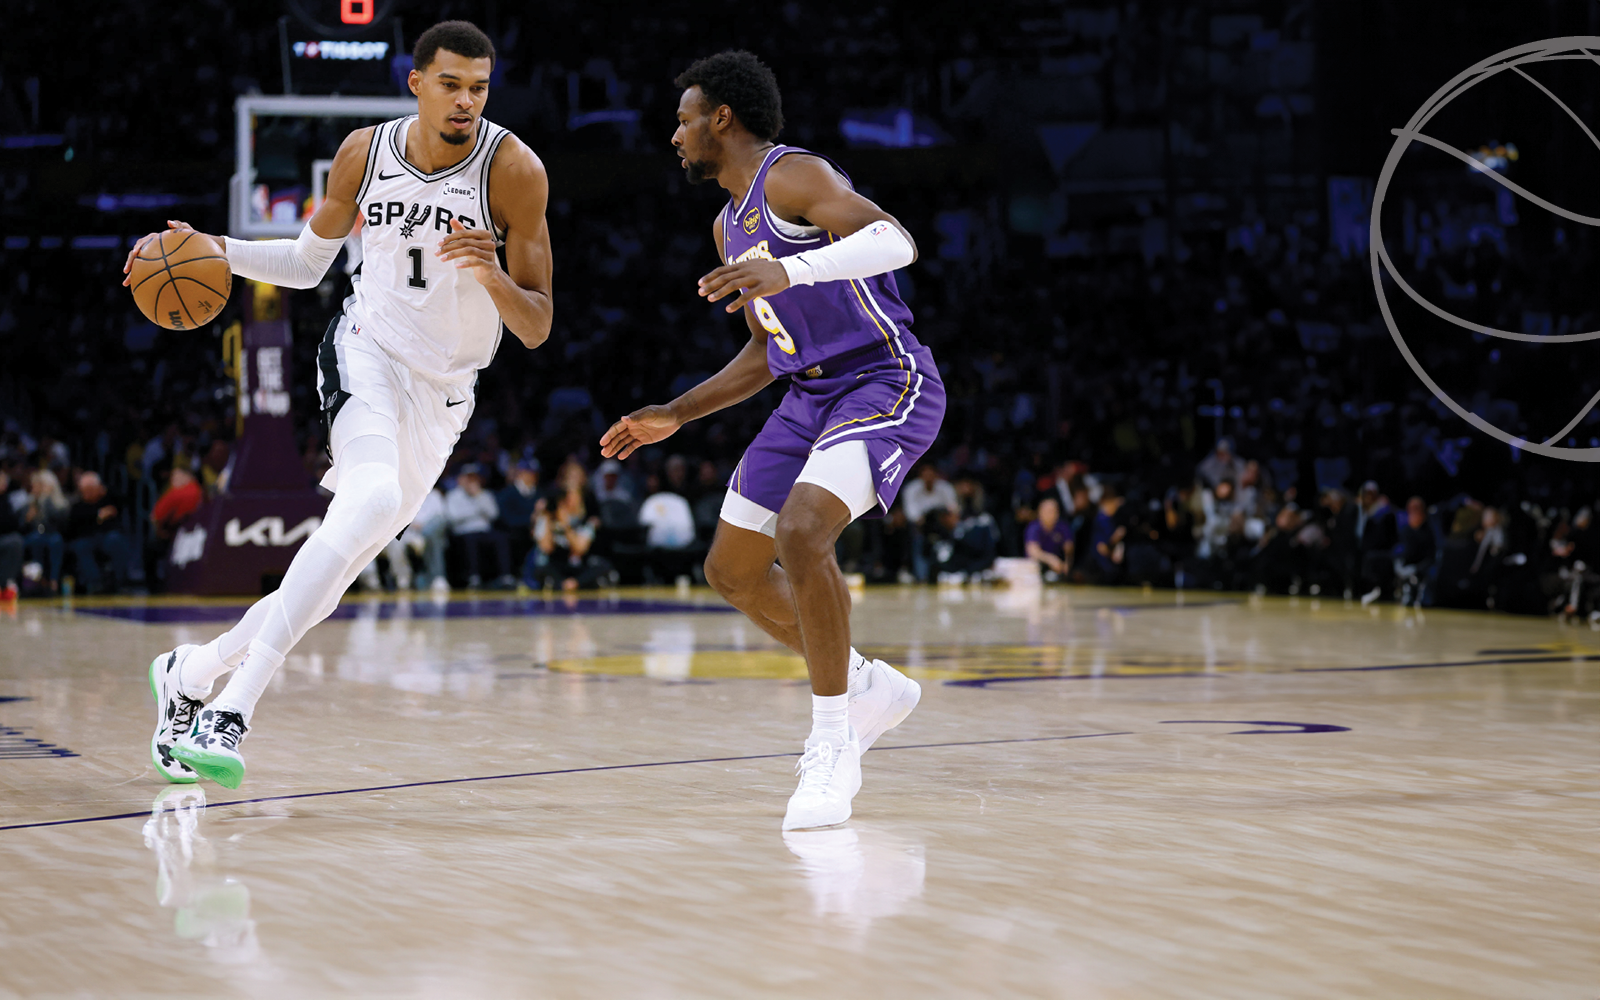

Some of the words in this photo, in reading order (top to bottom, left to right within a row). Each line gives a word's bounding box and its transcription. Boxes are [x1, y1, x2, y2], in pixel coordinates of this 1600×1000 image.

[319, 41, 389, 60] TISSOT
[447, 187, 471, 196] LEDGER
[407, 246, 428, 291] 1
[753, 297, 796, 355] 9
[225, 516, 323, 546] KIA
